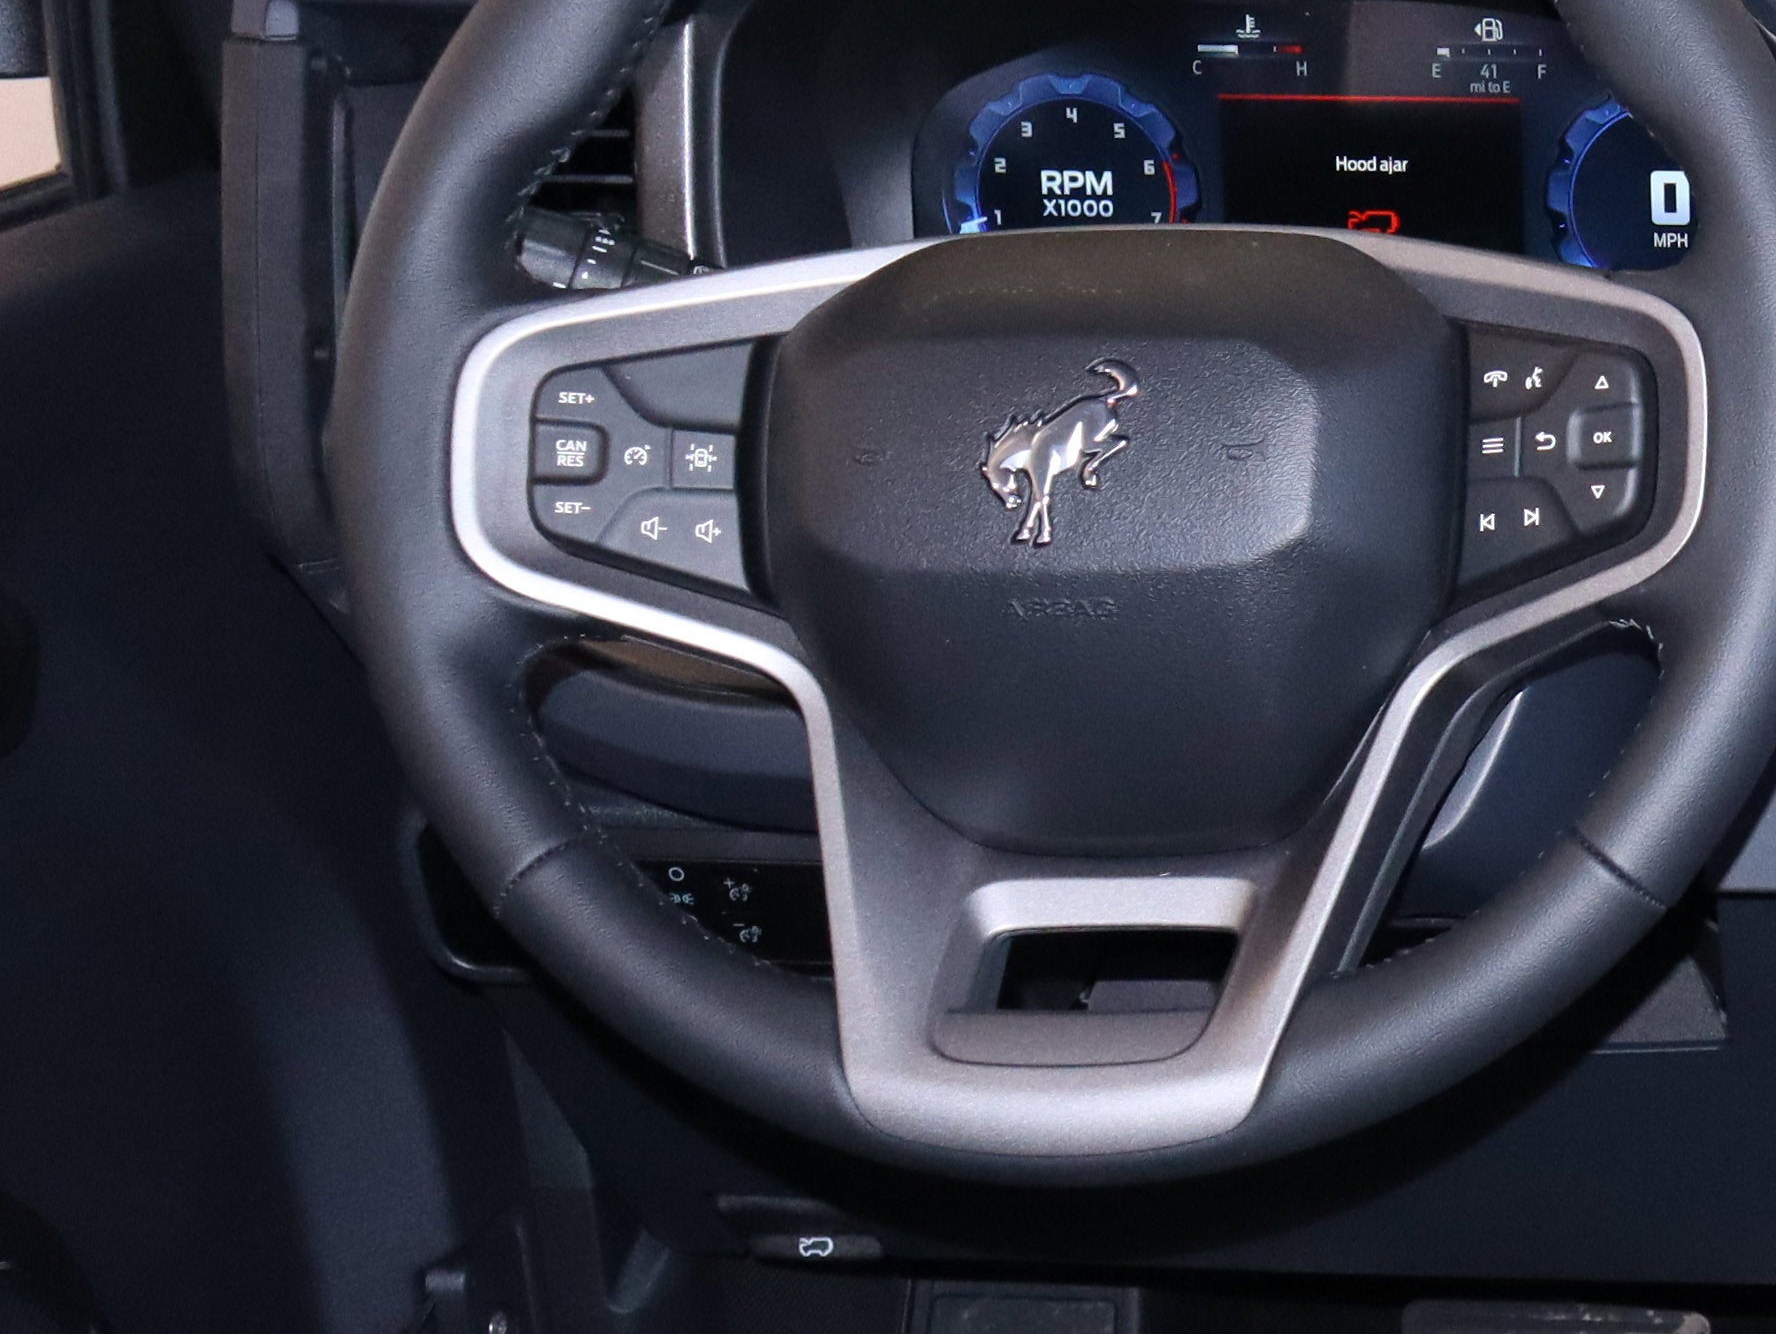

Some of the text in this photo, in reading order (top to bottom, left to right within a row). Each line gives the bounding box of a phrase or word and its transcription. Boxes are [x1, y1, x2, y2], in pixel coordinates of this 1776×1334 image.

[1192, 61, 1202, 75] C
[1296, 62, 1308, 77] H
[1432, 64, 1441, 78] E
[1480, 64, 1498, 79] 41
[1537, 65, 1546, 79] F
[1470, 82, 1511, 94] mi to E
[1066, 107, 1078, 123] 4
[1021, 122, 1033, 138] 3
[1113, 123, 1125, 139] 5
[994, 158, 1006, 173] 2
[1143, 160, 1155, 175] 6
[1336, 156, 1409, 175] Hood ajar
[1041, 170, 1113, 196] RPM
[1650, 170, 1691, 226] 0
[1043, 199, 1113, 217] X1000
[994, 210, 1002, 225] 1
[1151, 212, 1162, 223] 7
[1653, 232, 1688, 248] MPH
[558, 392, 595, 404] SET+
[1593, 431, 1612, 444] OK
[556, 439, 587, 452] CAN
[556, 455, 584, 467] RES
